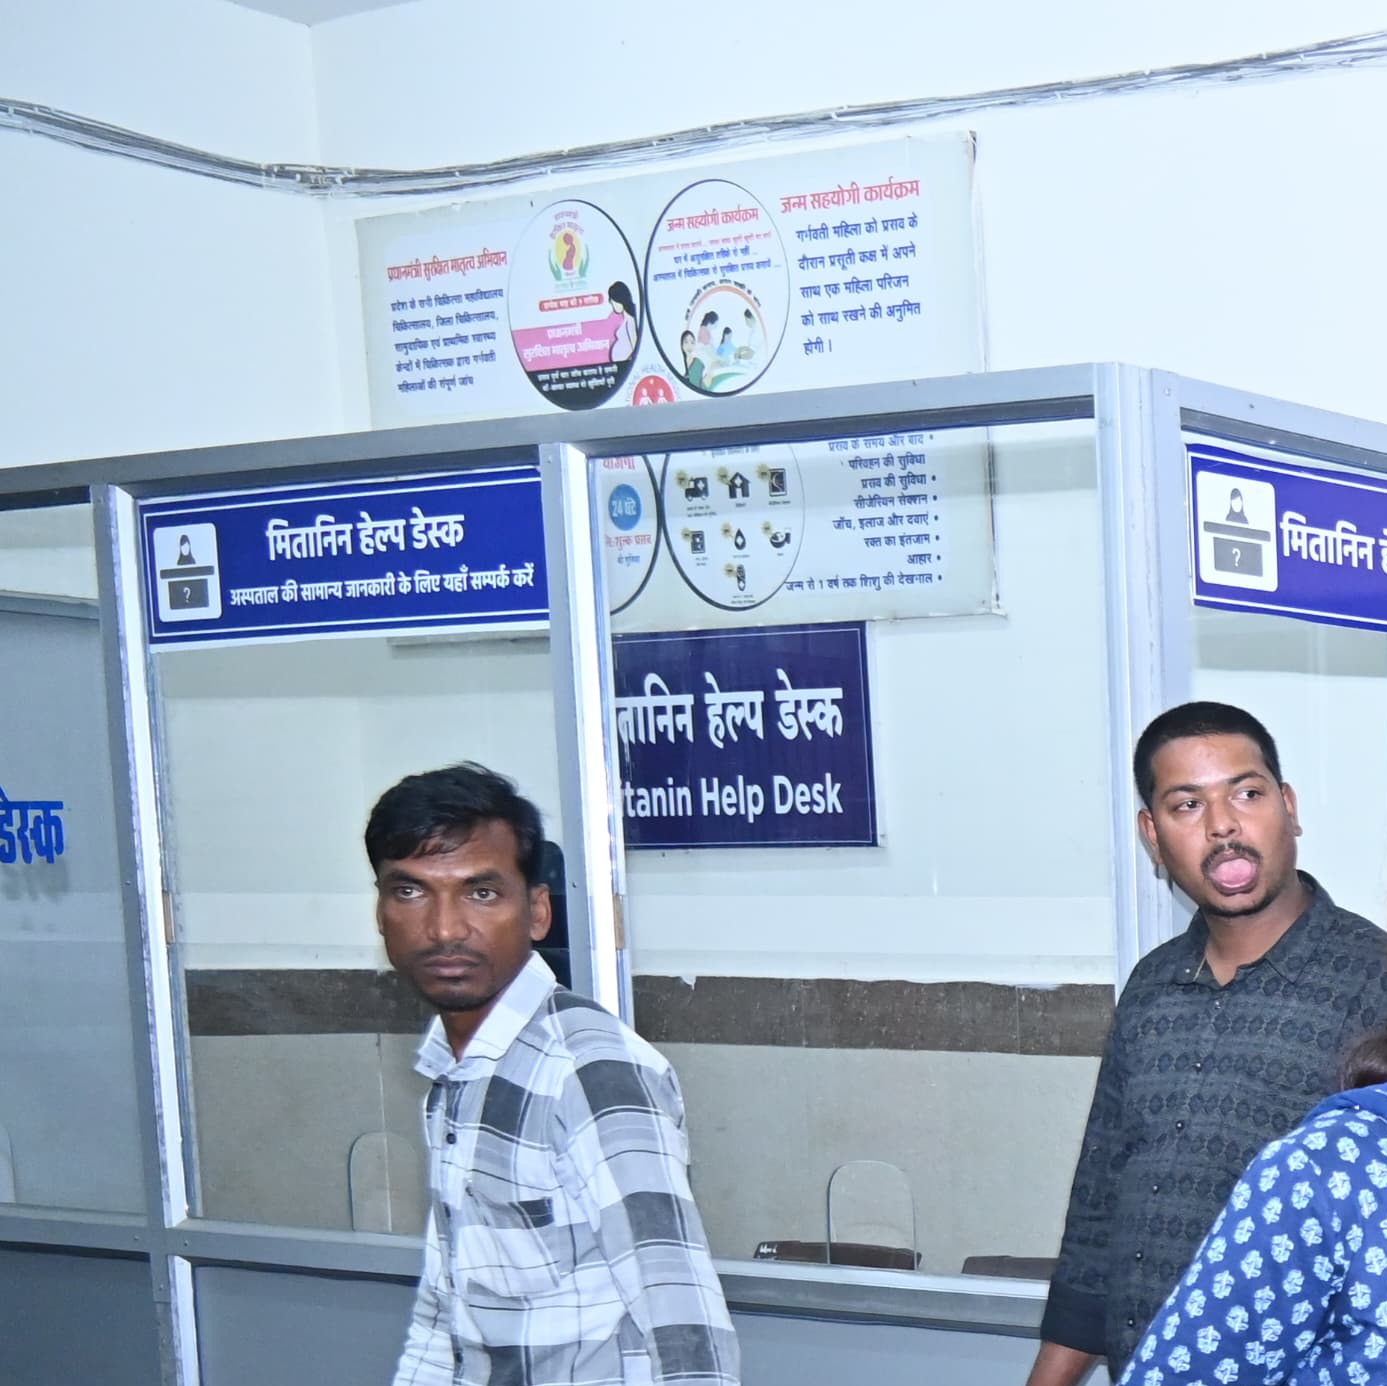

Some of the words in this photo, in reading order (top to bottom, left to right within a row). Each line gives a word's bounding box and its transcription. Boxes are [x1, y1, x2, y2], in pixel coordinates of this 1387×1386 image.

[780, 194, 807, 214] जन्म
[810, 181, 861, 210] सहयोगी
[864, 176, 920, 201] कार्यक्रम
[795, 222, 829, 243] गर्भवती
[832, 220, 862, 238] महिला
[864, 217, 878, 234] को
[882, 216, 905, 232] प्रसव
[907, 211, 918, 228] के
[798, 253, 825, 271] दौरान
[859, 249, 877, 263] कक्ष
[880, 244, 888, 261] में
[893, 241, 916, 259] अपने
[800, 285, 821, 299] साथ
[824, 282, 840, 298] एक
[843, 276, 873, 294] महिला
[876, 272, 909, 290] परिजन
[801, 310, 815, 327] को
[817, 311, 839, 325] साथ
[842, 304, 866, 322] रखने
[869, 302, 882, 320] की
[803, 336, 824, 356] होगी
[882, 453, 894, 467] की
[883, 473, 896, 487] की
[899, 471, 927, 490] सुविधा
[266, 514, 353, 561] मितानिन
[357, 511, 407, 556] हेल्प
[409, 507, 465, 550] डेस्क
[887, 512, 904, 526] और
[884, 536, 896, 547] का
[1280, 511, 1375, 570] मितानिन
[230, 585, 279, 607] अस्पताल
[281, 579, 299, 602] की
[300, 581, 342, 601] सामान्य
[344, 573, 396, 597] जानकारी
[397, 572, 413, 595] के
[414, 569, 441, 594] लिए
[443, 565, 468, 592] यहाँ
[469, 566, 510, 590] सम्पर्क
[512, 562, 535, 587] करें
[615, 672, 695, 745] तानिन
[704, 671, 765, 749] हेल्प
[775, 668, 843, 741] डेस्क
[624, 777, 693, 818] tanin
[700, 775, 764, 824] Help
[773, 772, 843, 815] Desk
